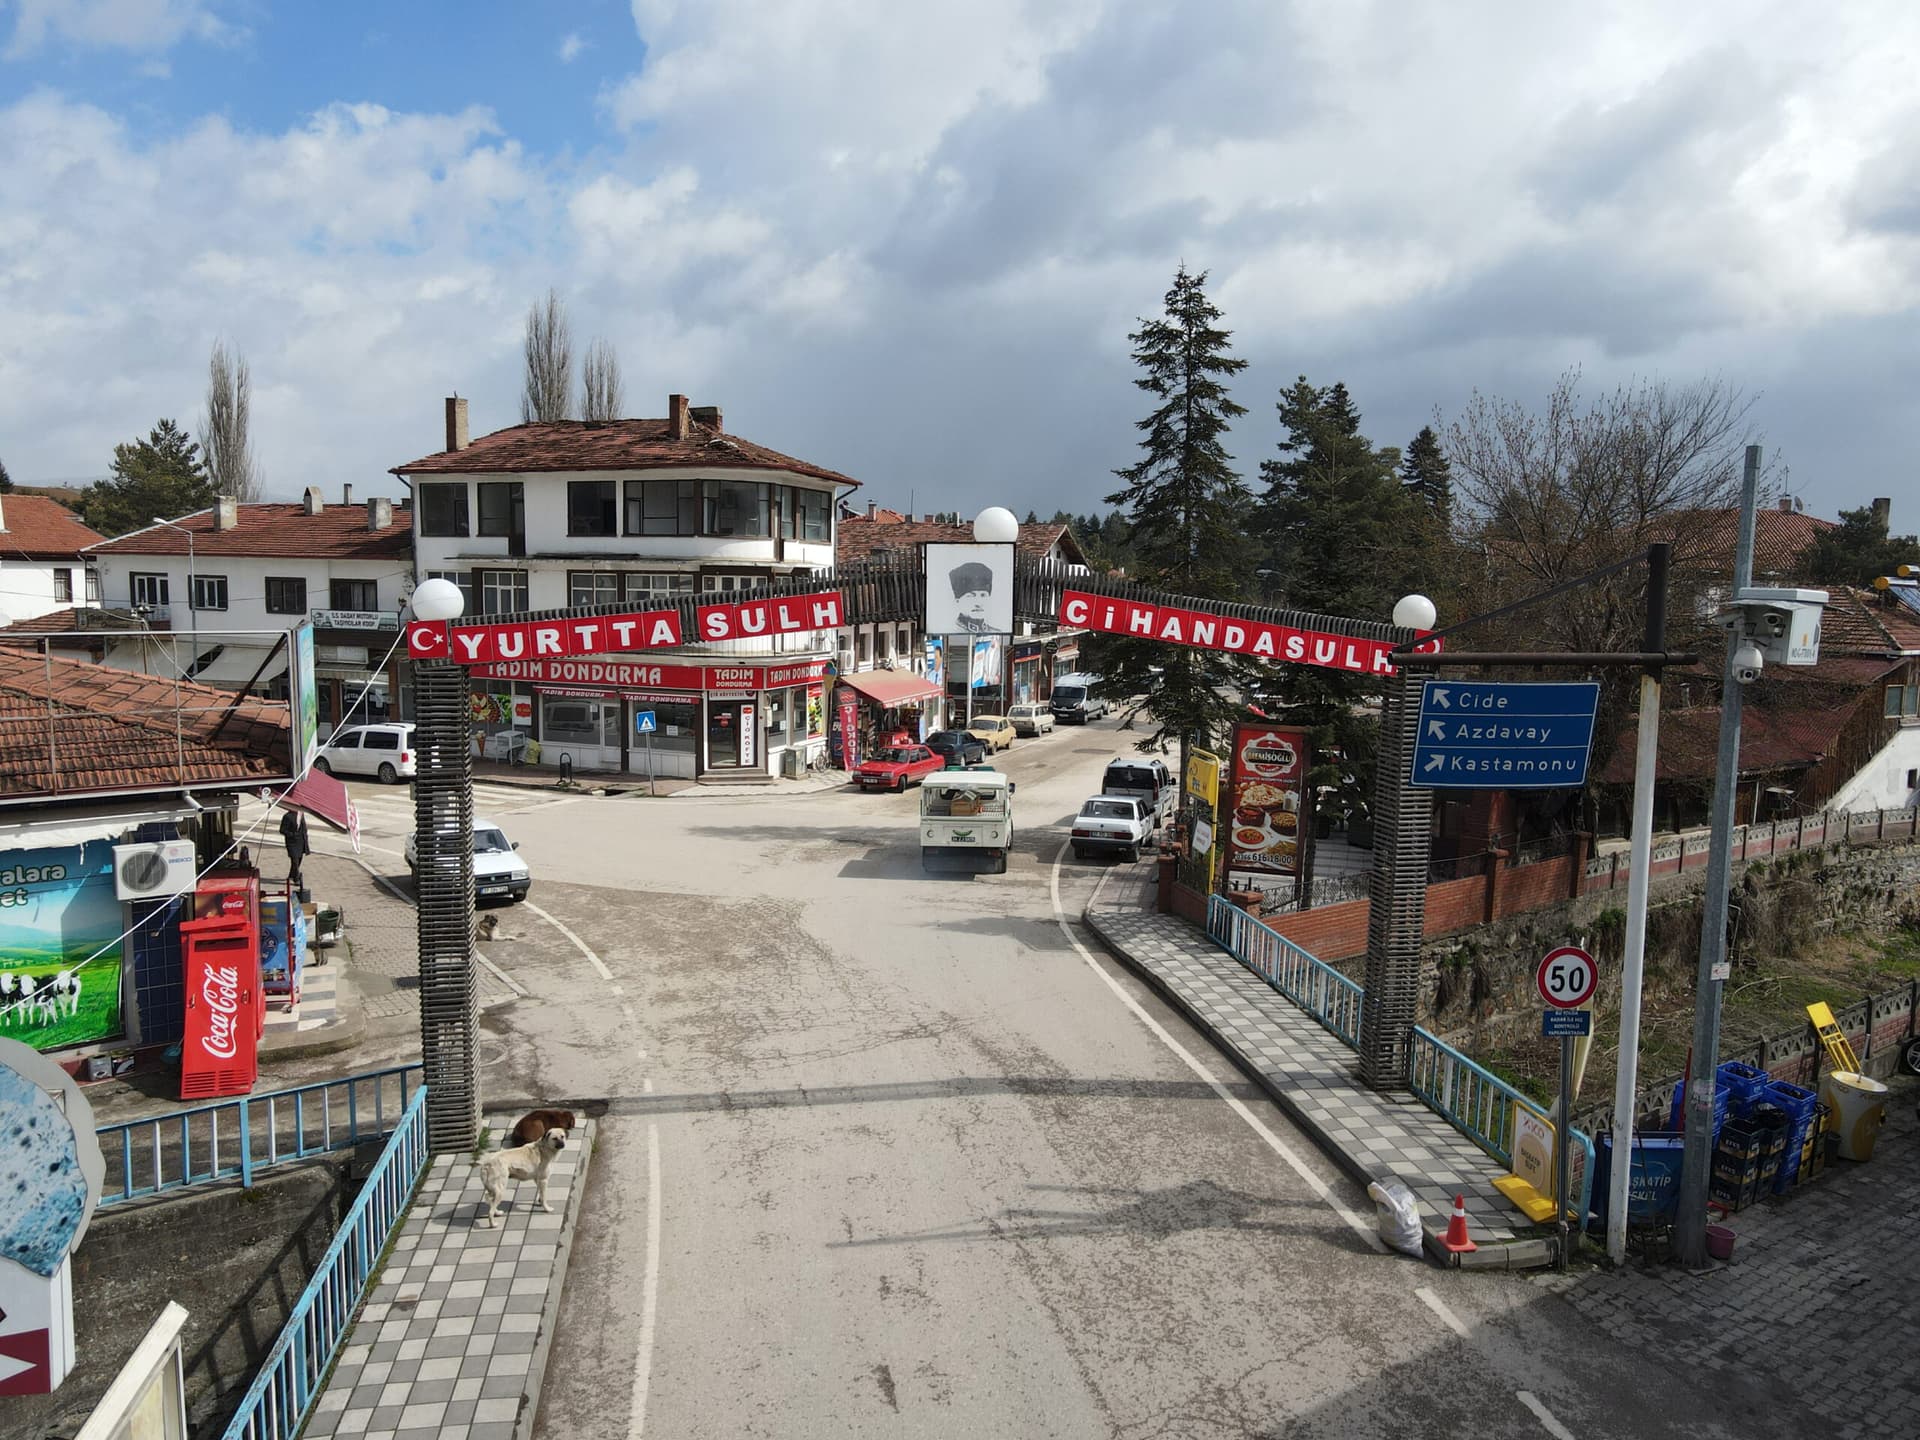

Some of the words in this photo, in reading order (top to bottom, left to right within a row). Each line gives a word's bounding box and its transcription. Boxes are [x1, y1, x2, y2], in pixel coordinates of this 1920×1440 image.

[457, 619, 676, 659] YURTTA
[706, 601, 838, 637] SULH
[487, 661, 543, 679] TADIM
[550, 662, 662, 684] DONDURMA
[714, 669, 754, 680] TADIM
[770, 669, 791, 684] TADIM
[792, 664, 826, 680] DONDURM
[1459, 692, 1508, 708] Cide
[1455, 723, 1551, 743] Azdavay
[1451, 755, 1577, 771] Kastamonu
[0, 865, 66, 886] alara
[0, 888, 28, 907] et
[1550, 965, 1585, 993] 50
[201, 962, 239, 1059] Coca-Cola
